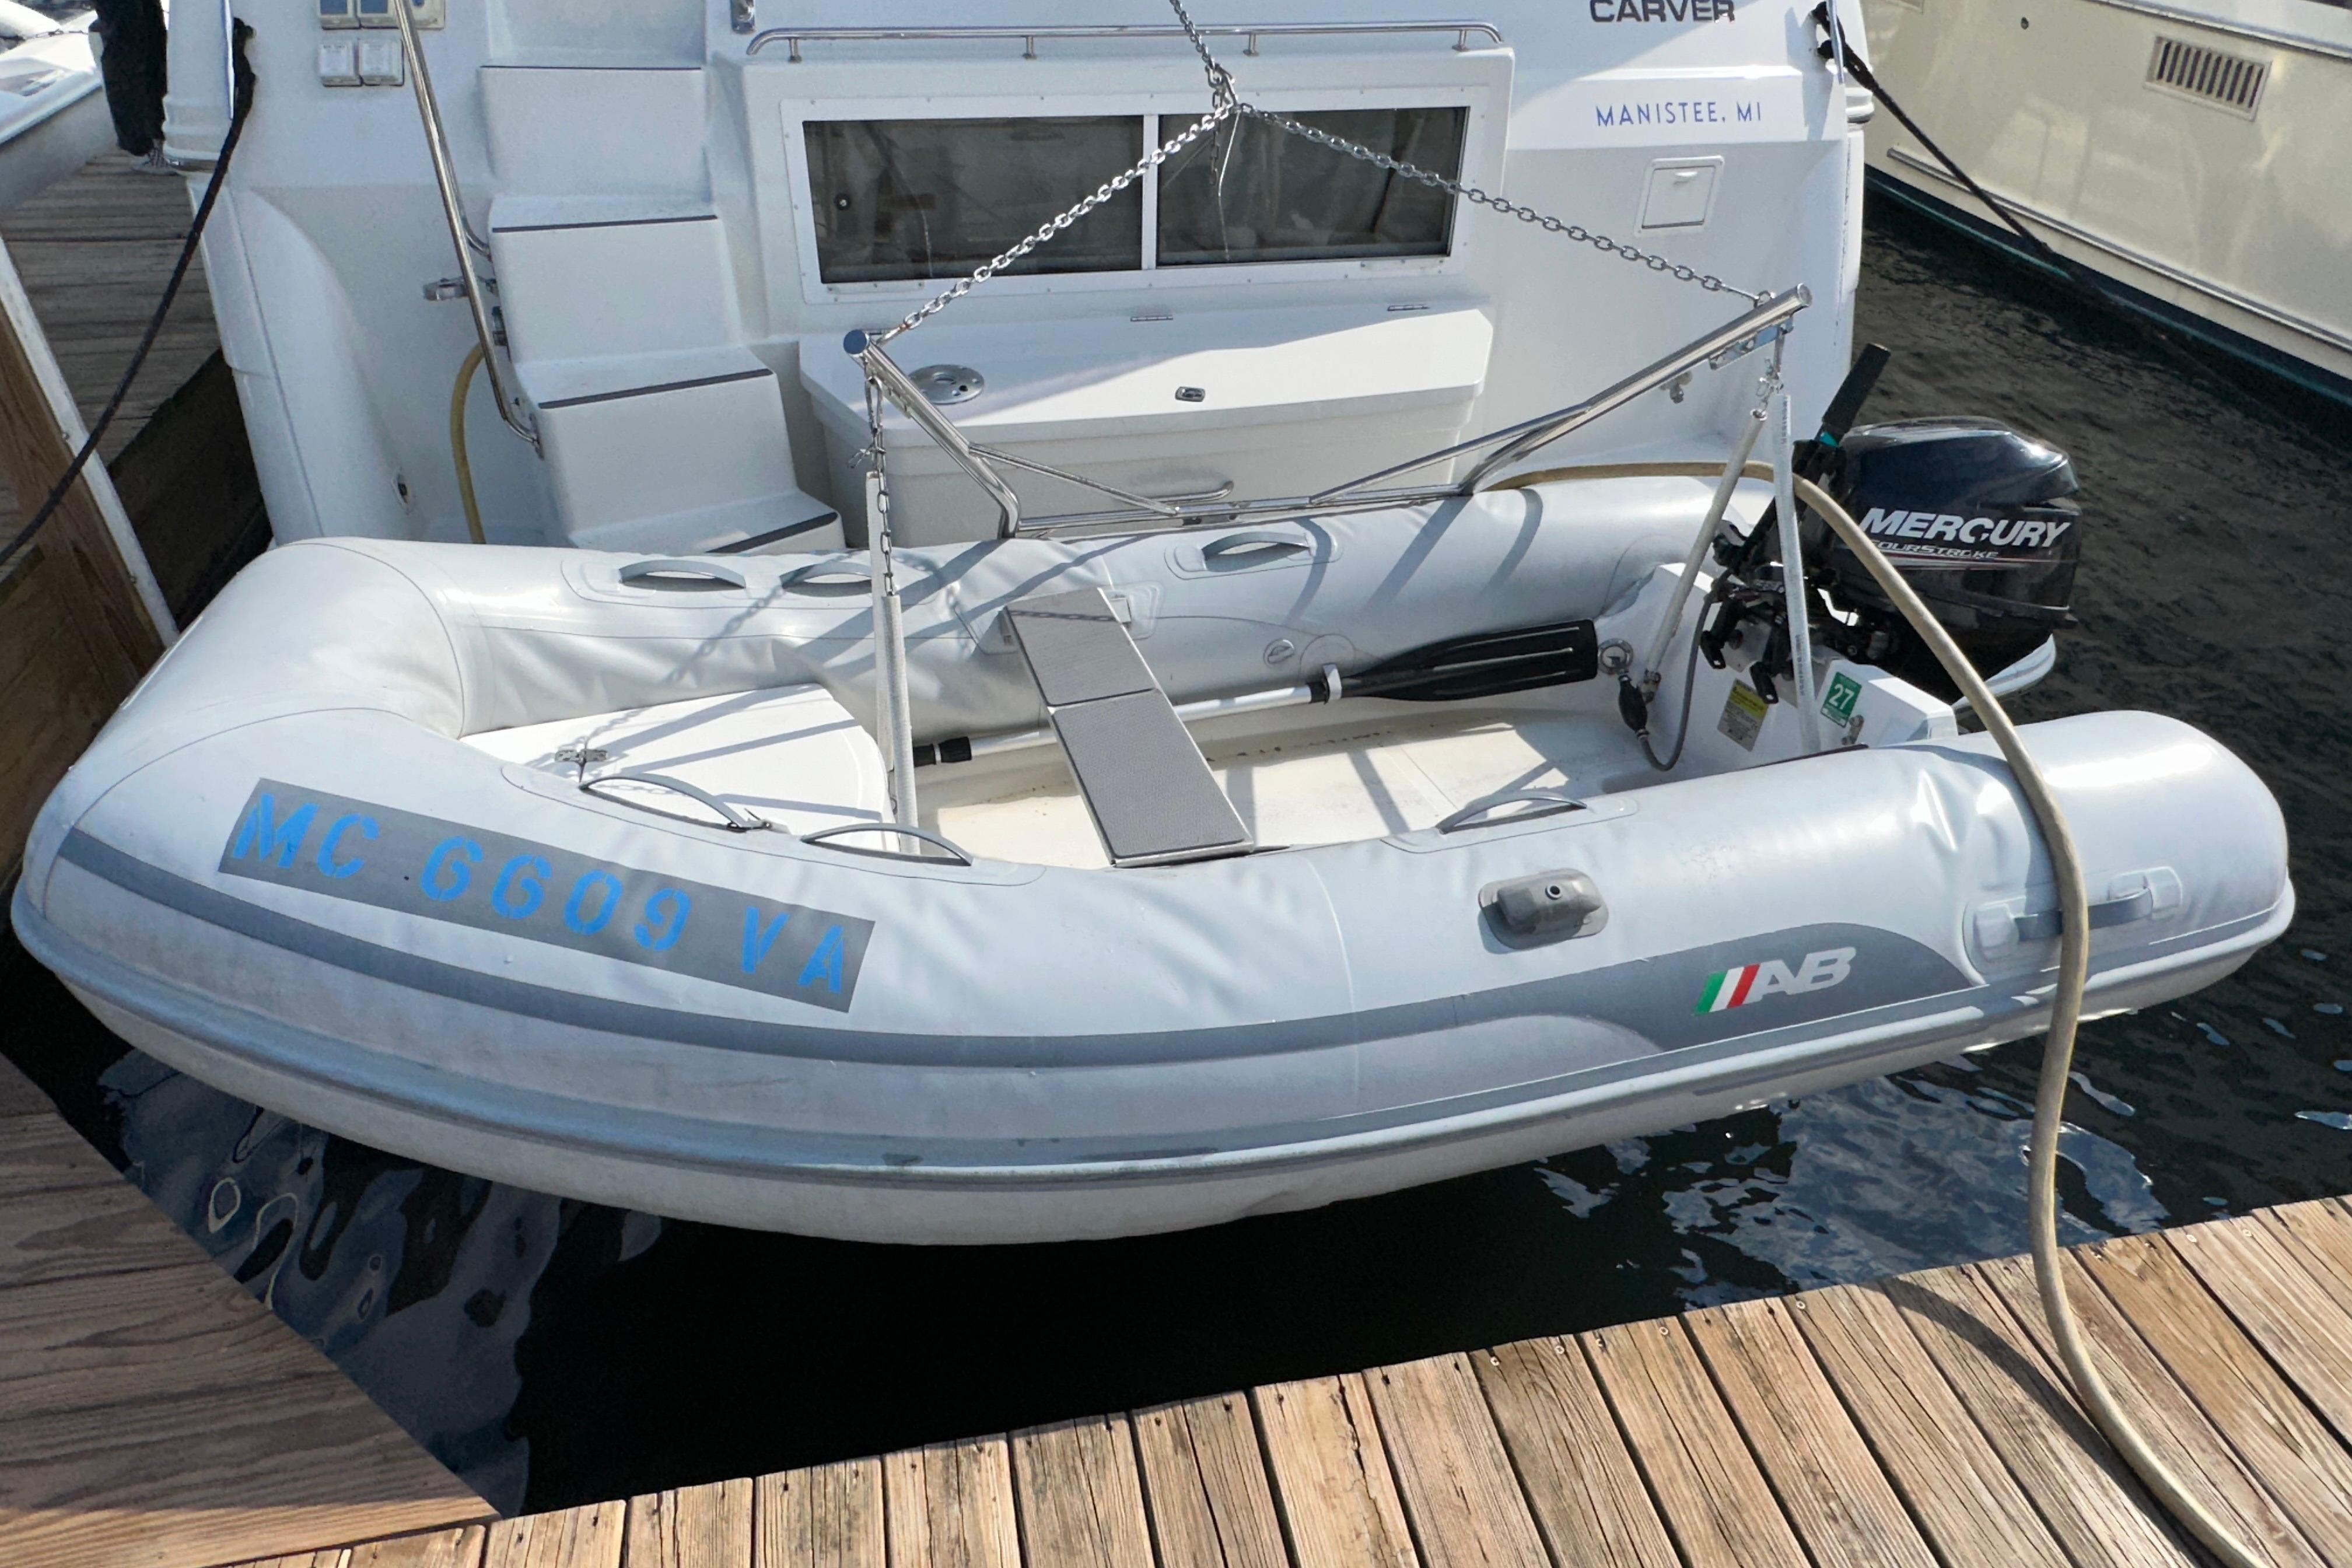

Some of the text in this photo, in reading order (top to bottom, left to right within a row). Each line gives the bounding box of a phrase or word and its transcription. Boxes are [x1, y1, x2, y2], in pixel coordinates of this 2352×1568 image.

[1590, 0, 1735, 23] CARVER
[1736, 102, 1761, 121] MI
[1859, 508, 2070, 547] MERCURY
[1829, 683, 1854, 710] 27
[232, 793, 844, 995] MC 6609 VA
[1742, 947, 1856, 1005] AB
